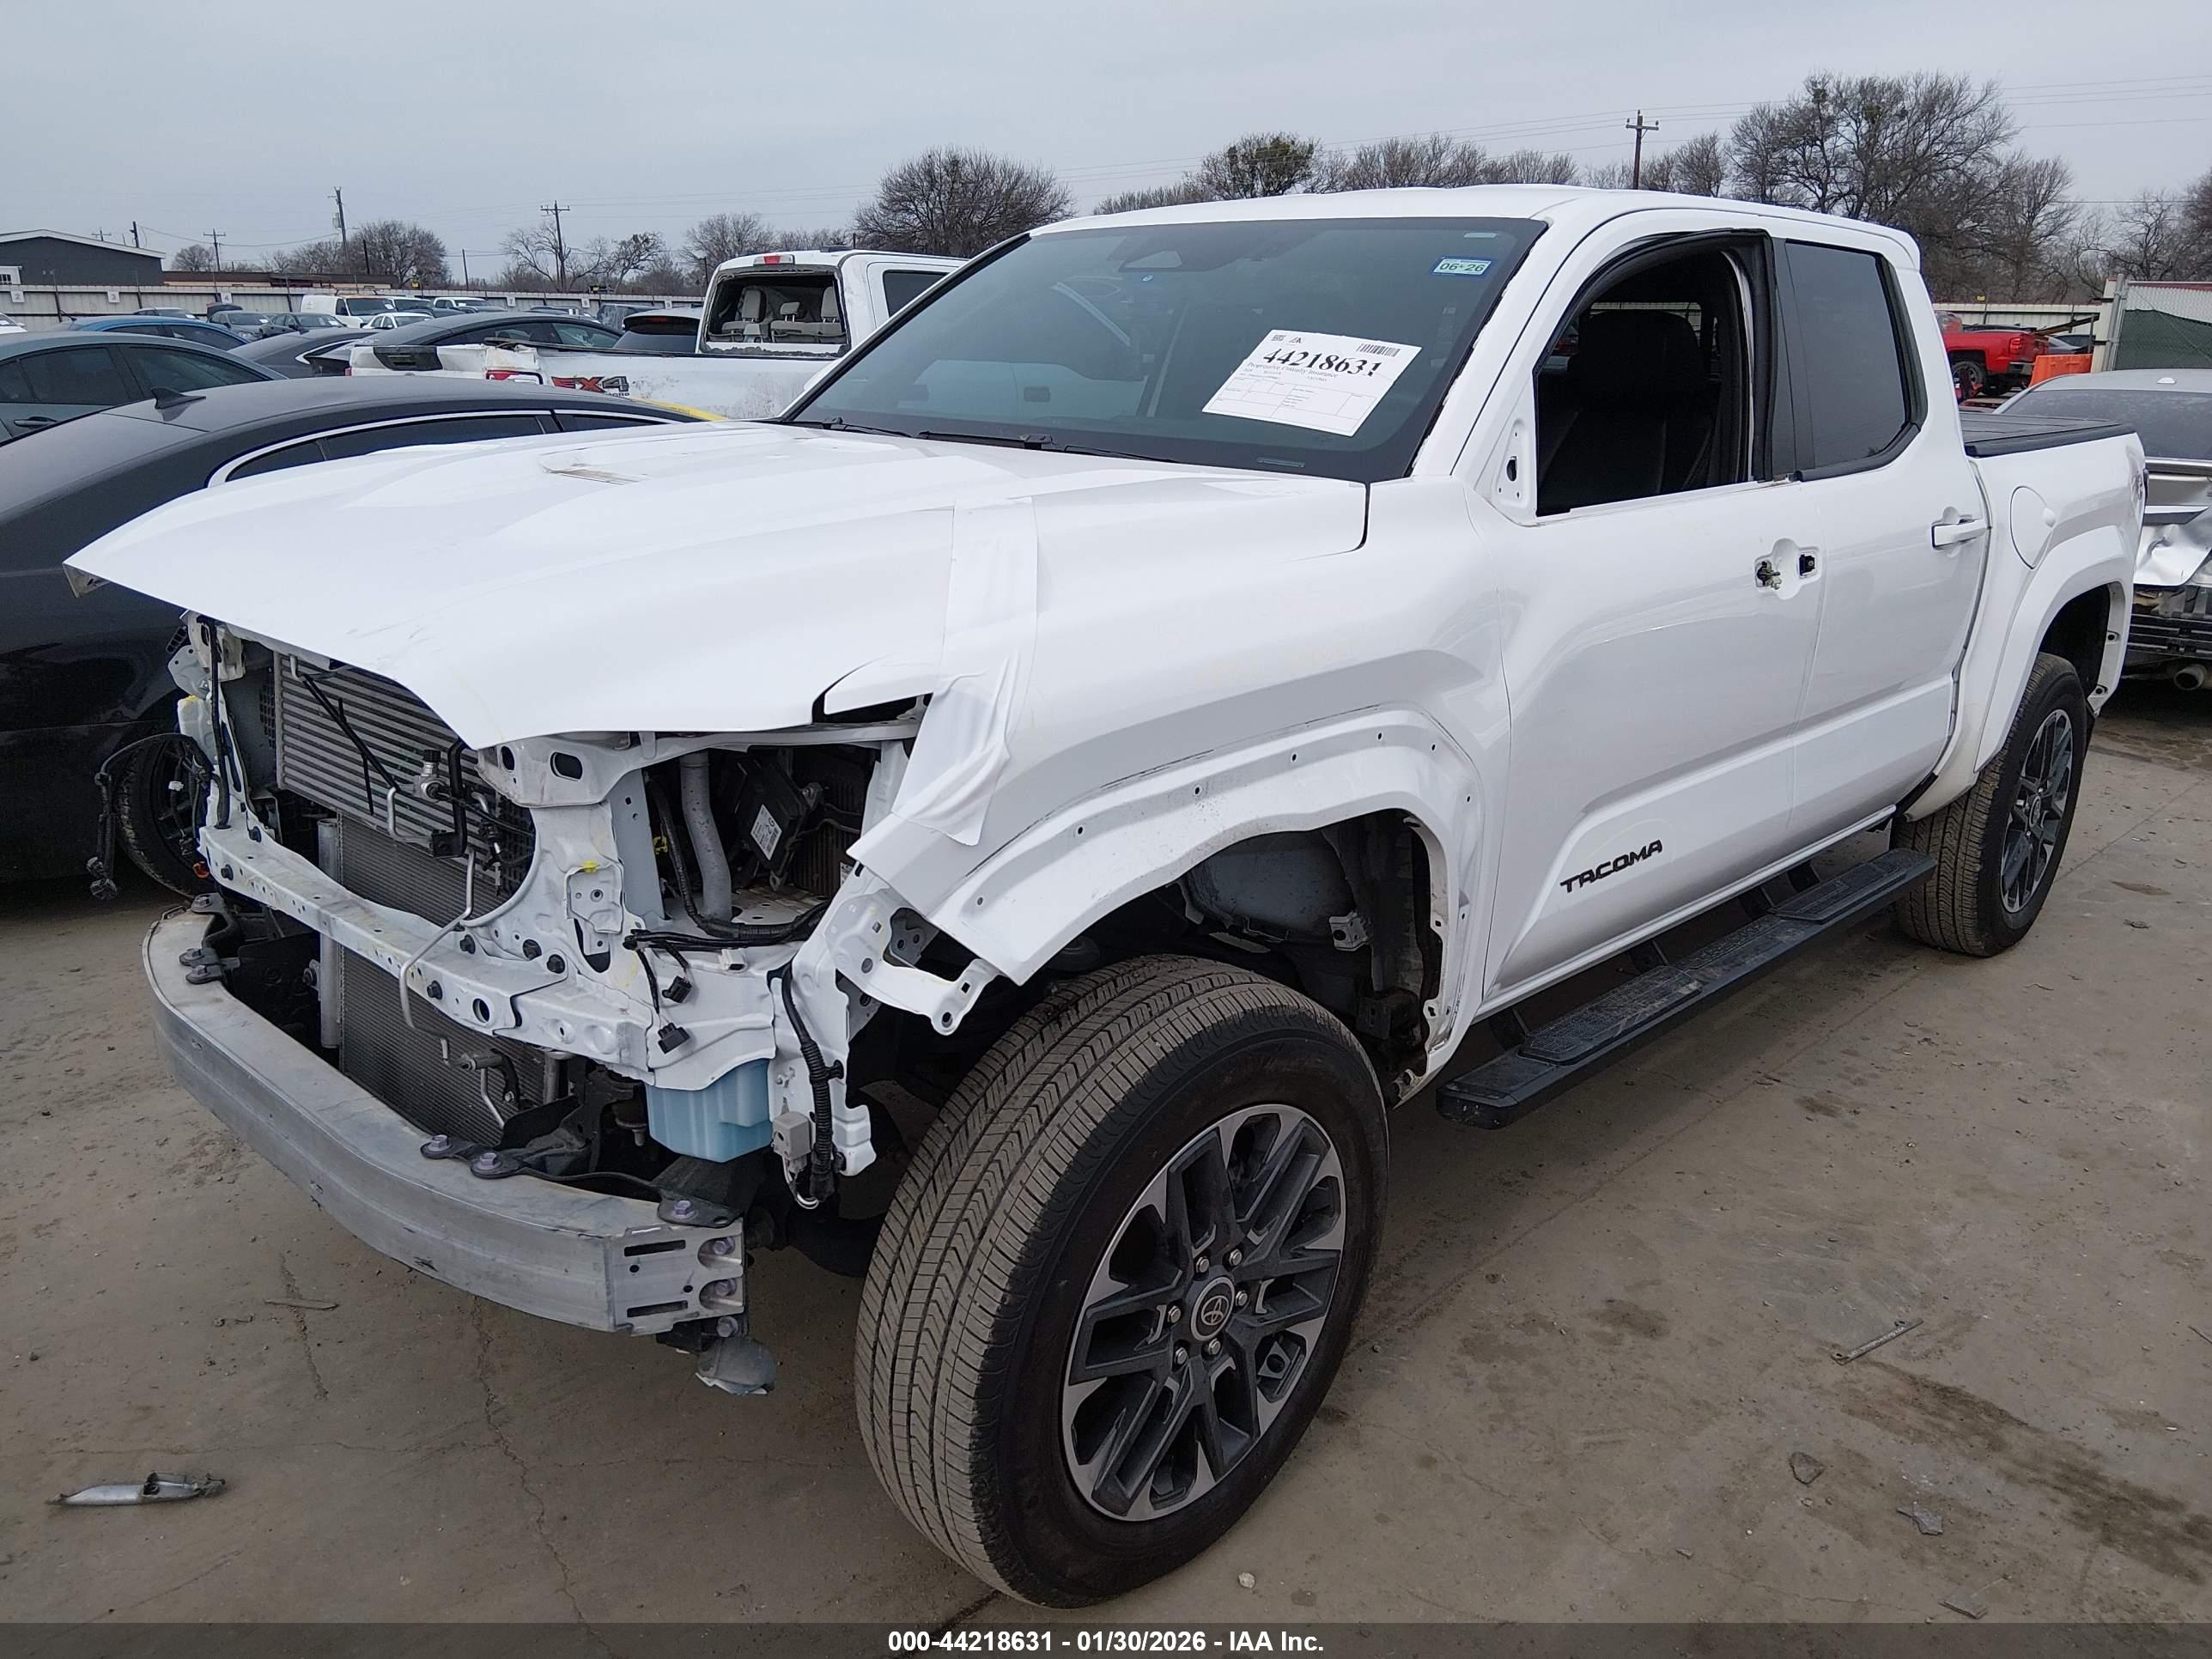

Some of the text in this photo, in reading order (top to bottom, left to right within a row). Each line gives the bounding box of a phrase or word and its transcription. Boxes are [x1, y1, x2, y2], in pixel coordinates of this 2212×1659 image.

[1463, 264, 1486, 272] 26
[1263, 348, 1382, 377] 44218631
[1559, 839, 1663, 894] TACOMA
